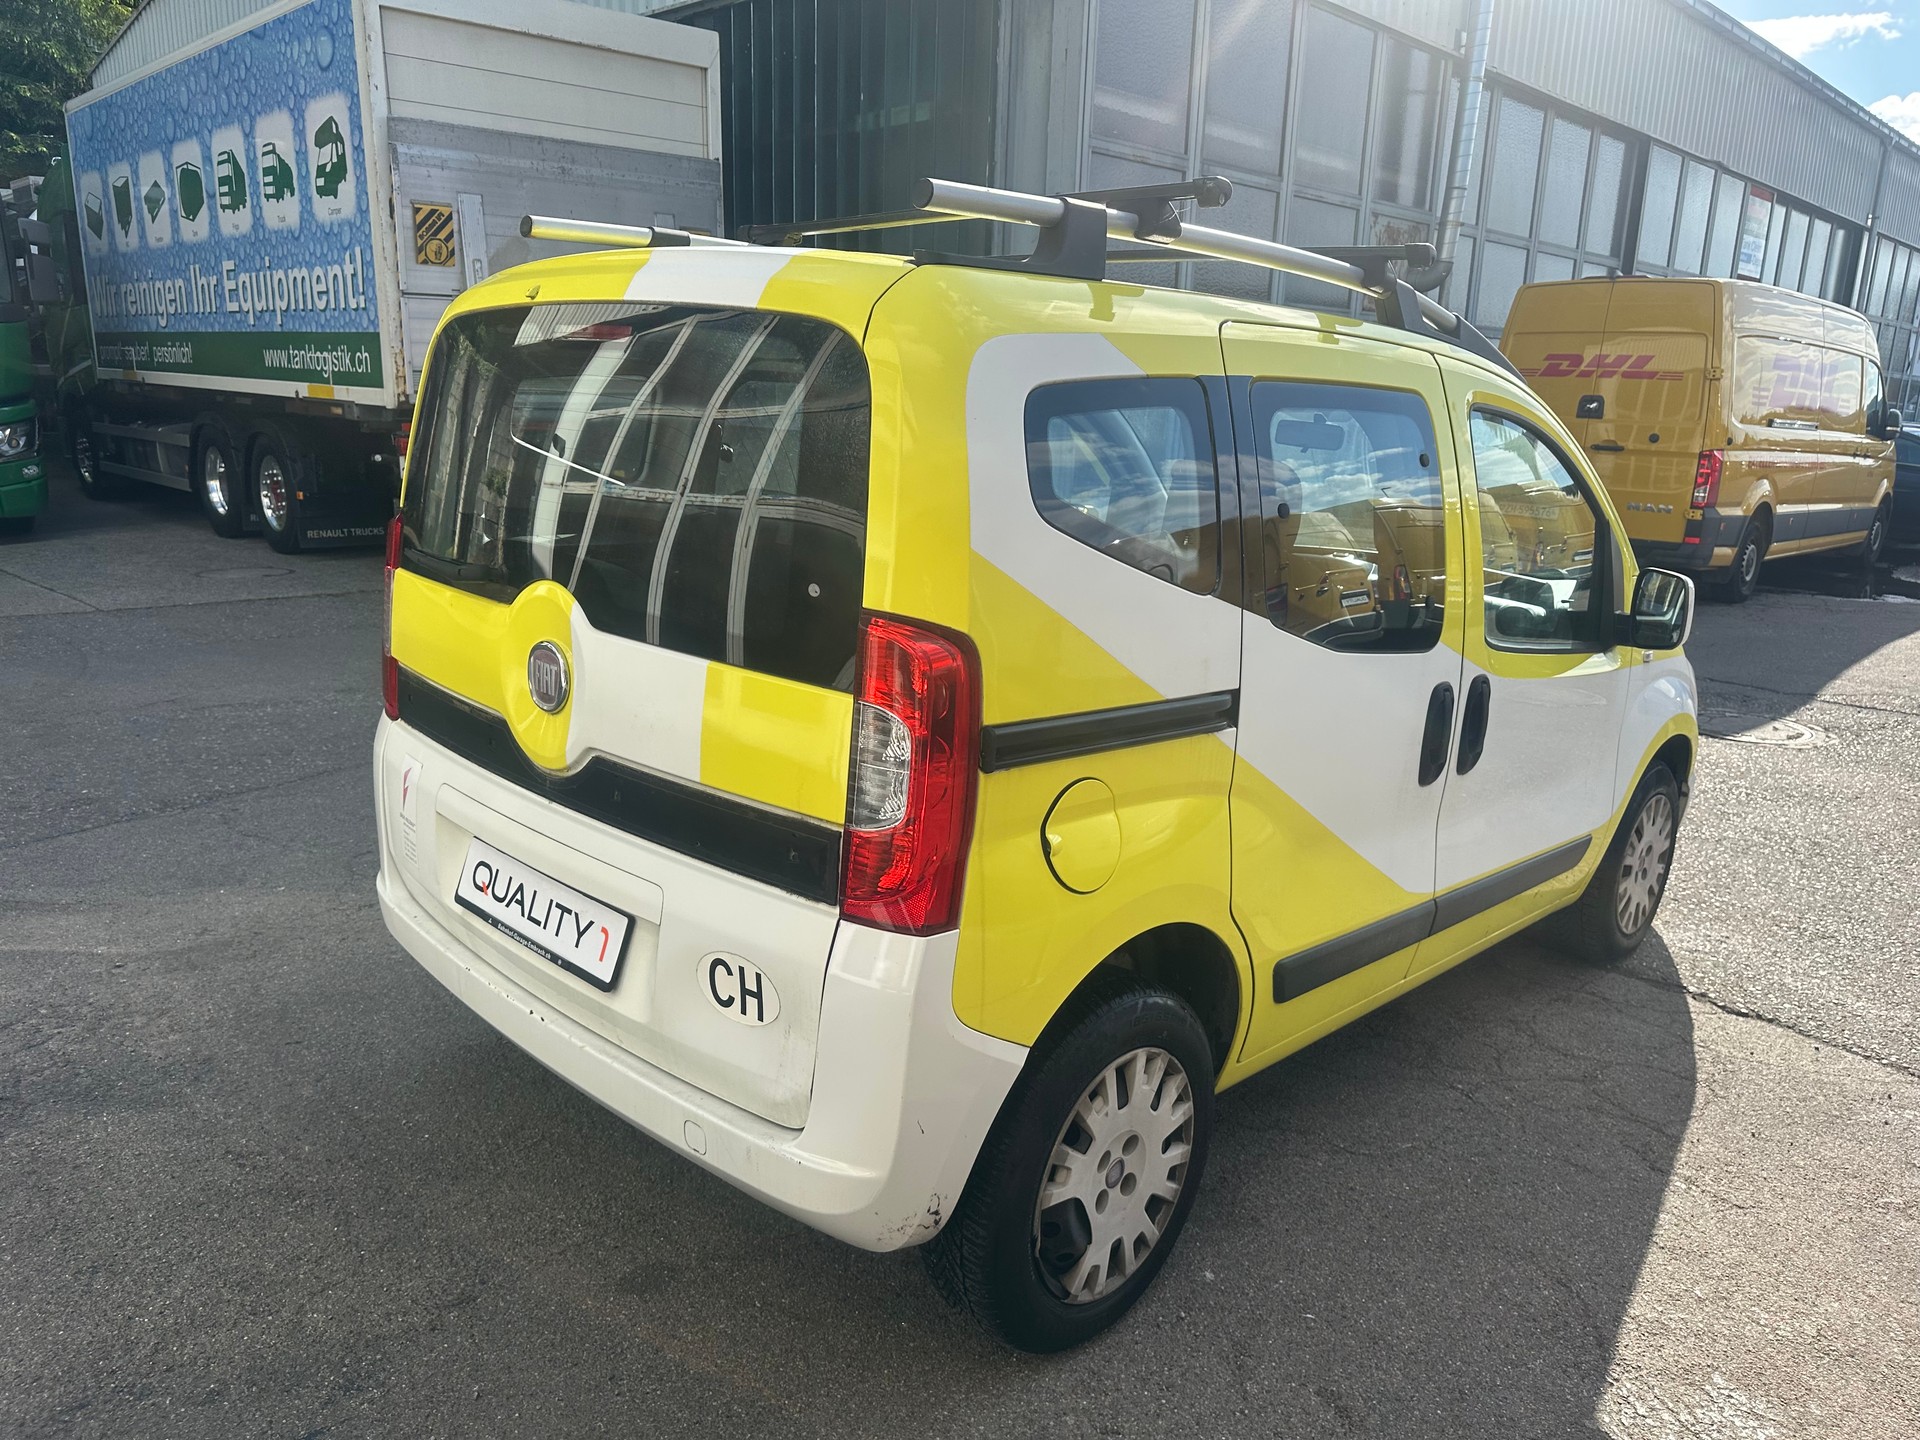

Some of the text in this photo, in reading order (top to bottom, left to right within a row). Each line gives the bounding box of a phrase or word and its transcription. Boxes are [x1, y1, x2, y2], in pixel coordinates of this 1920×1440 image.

[91, 246, 367, 328] Wir reinigen Ihr Equipment!
[152, 341, 193, 366] persönlich!
[263, 344, 371, 377] www.tanklogistik.ch
[1538, 353, 1660, 379] DHL
[1767, 354, 1842, 413] DHL
[1626, 502, 1673, 514] MAN
[307, 526, 385, 539] RENAULT TRUCKS
[535, 659, 558, 696] FIAT
[472, 860, 596, 949] QUALITY
[708, 957, 765, 1023] CH
